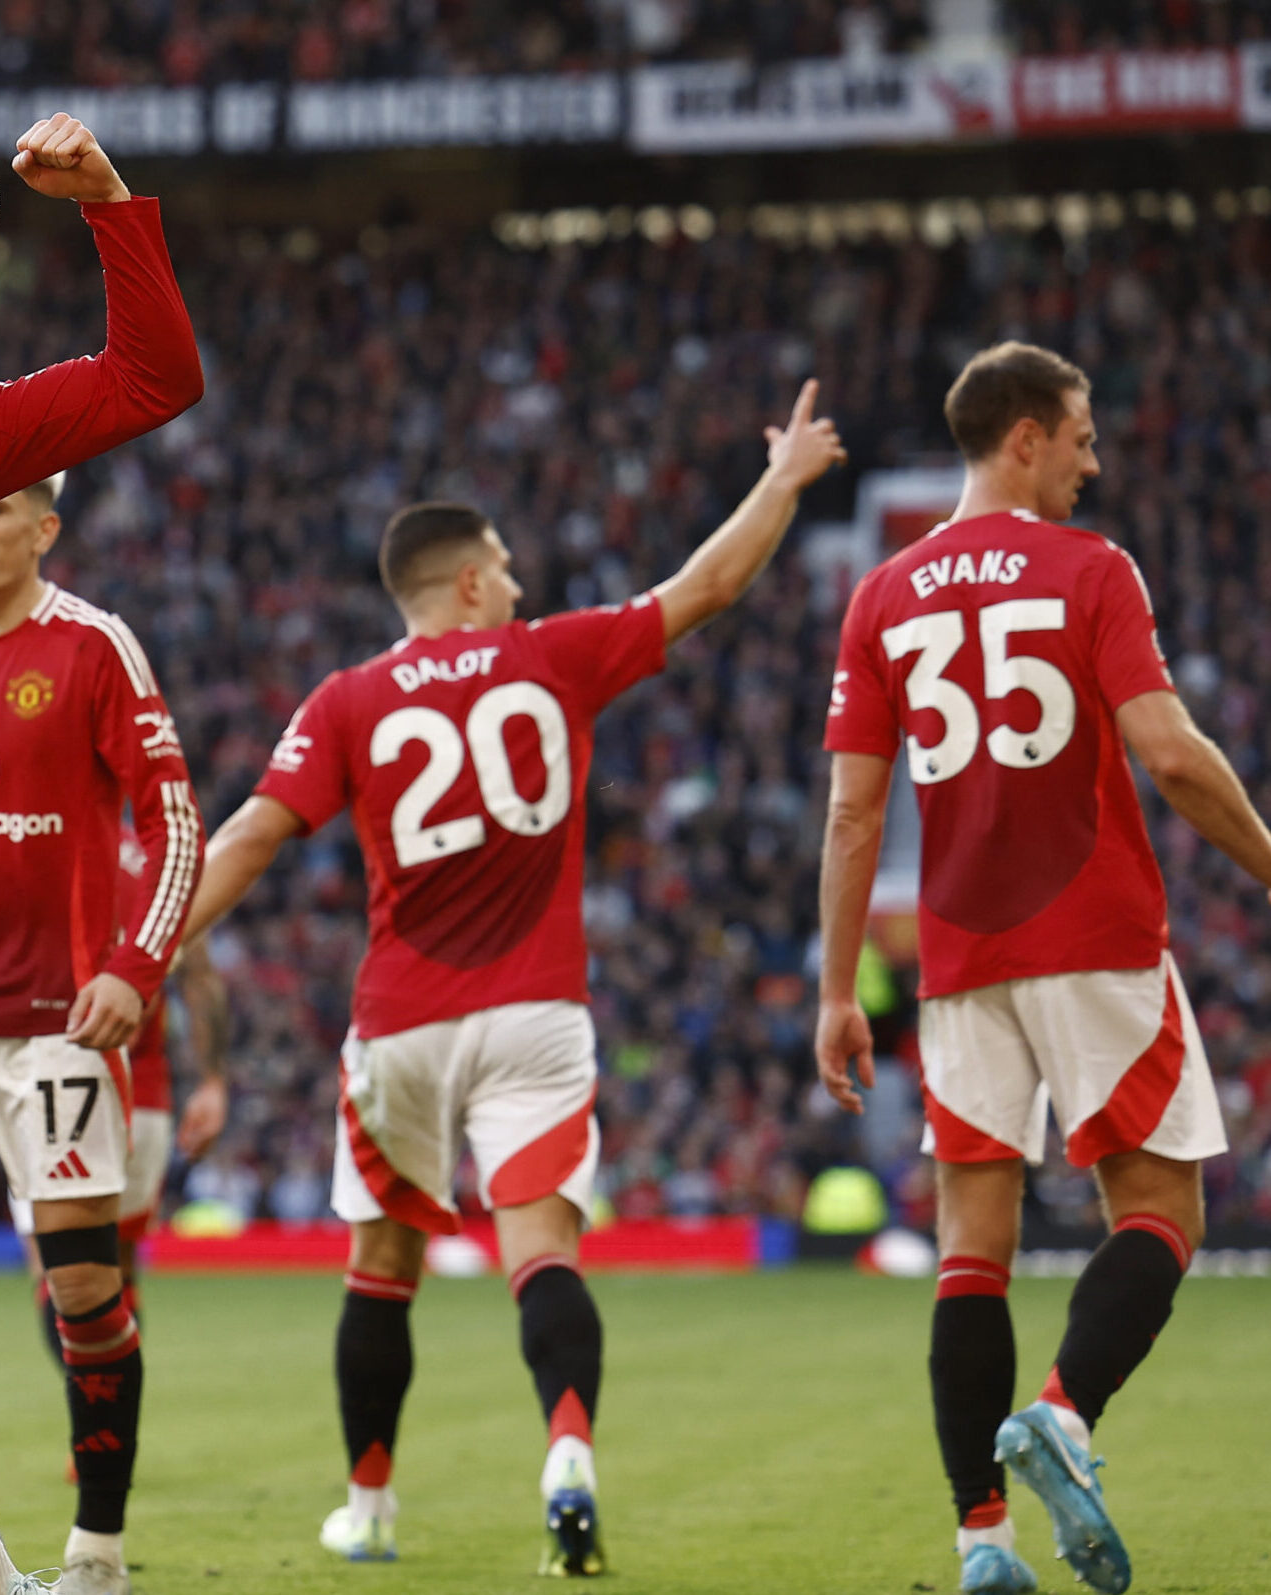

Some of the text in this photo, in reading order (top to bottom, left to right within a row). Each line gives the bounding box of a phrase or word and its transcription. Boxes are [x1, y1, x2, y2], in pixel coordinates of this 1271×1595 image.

[909, 550, 1028, 600] EVANS
[390, 645, 500, 694] DALOT
[881, 597, 1077, 785] 35
[369, 680, 573, 869] 20
[36, 1077, 99, 1144] 17
